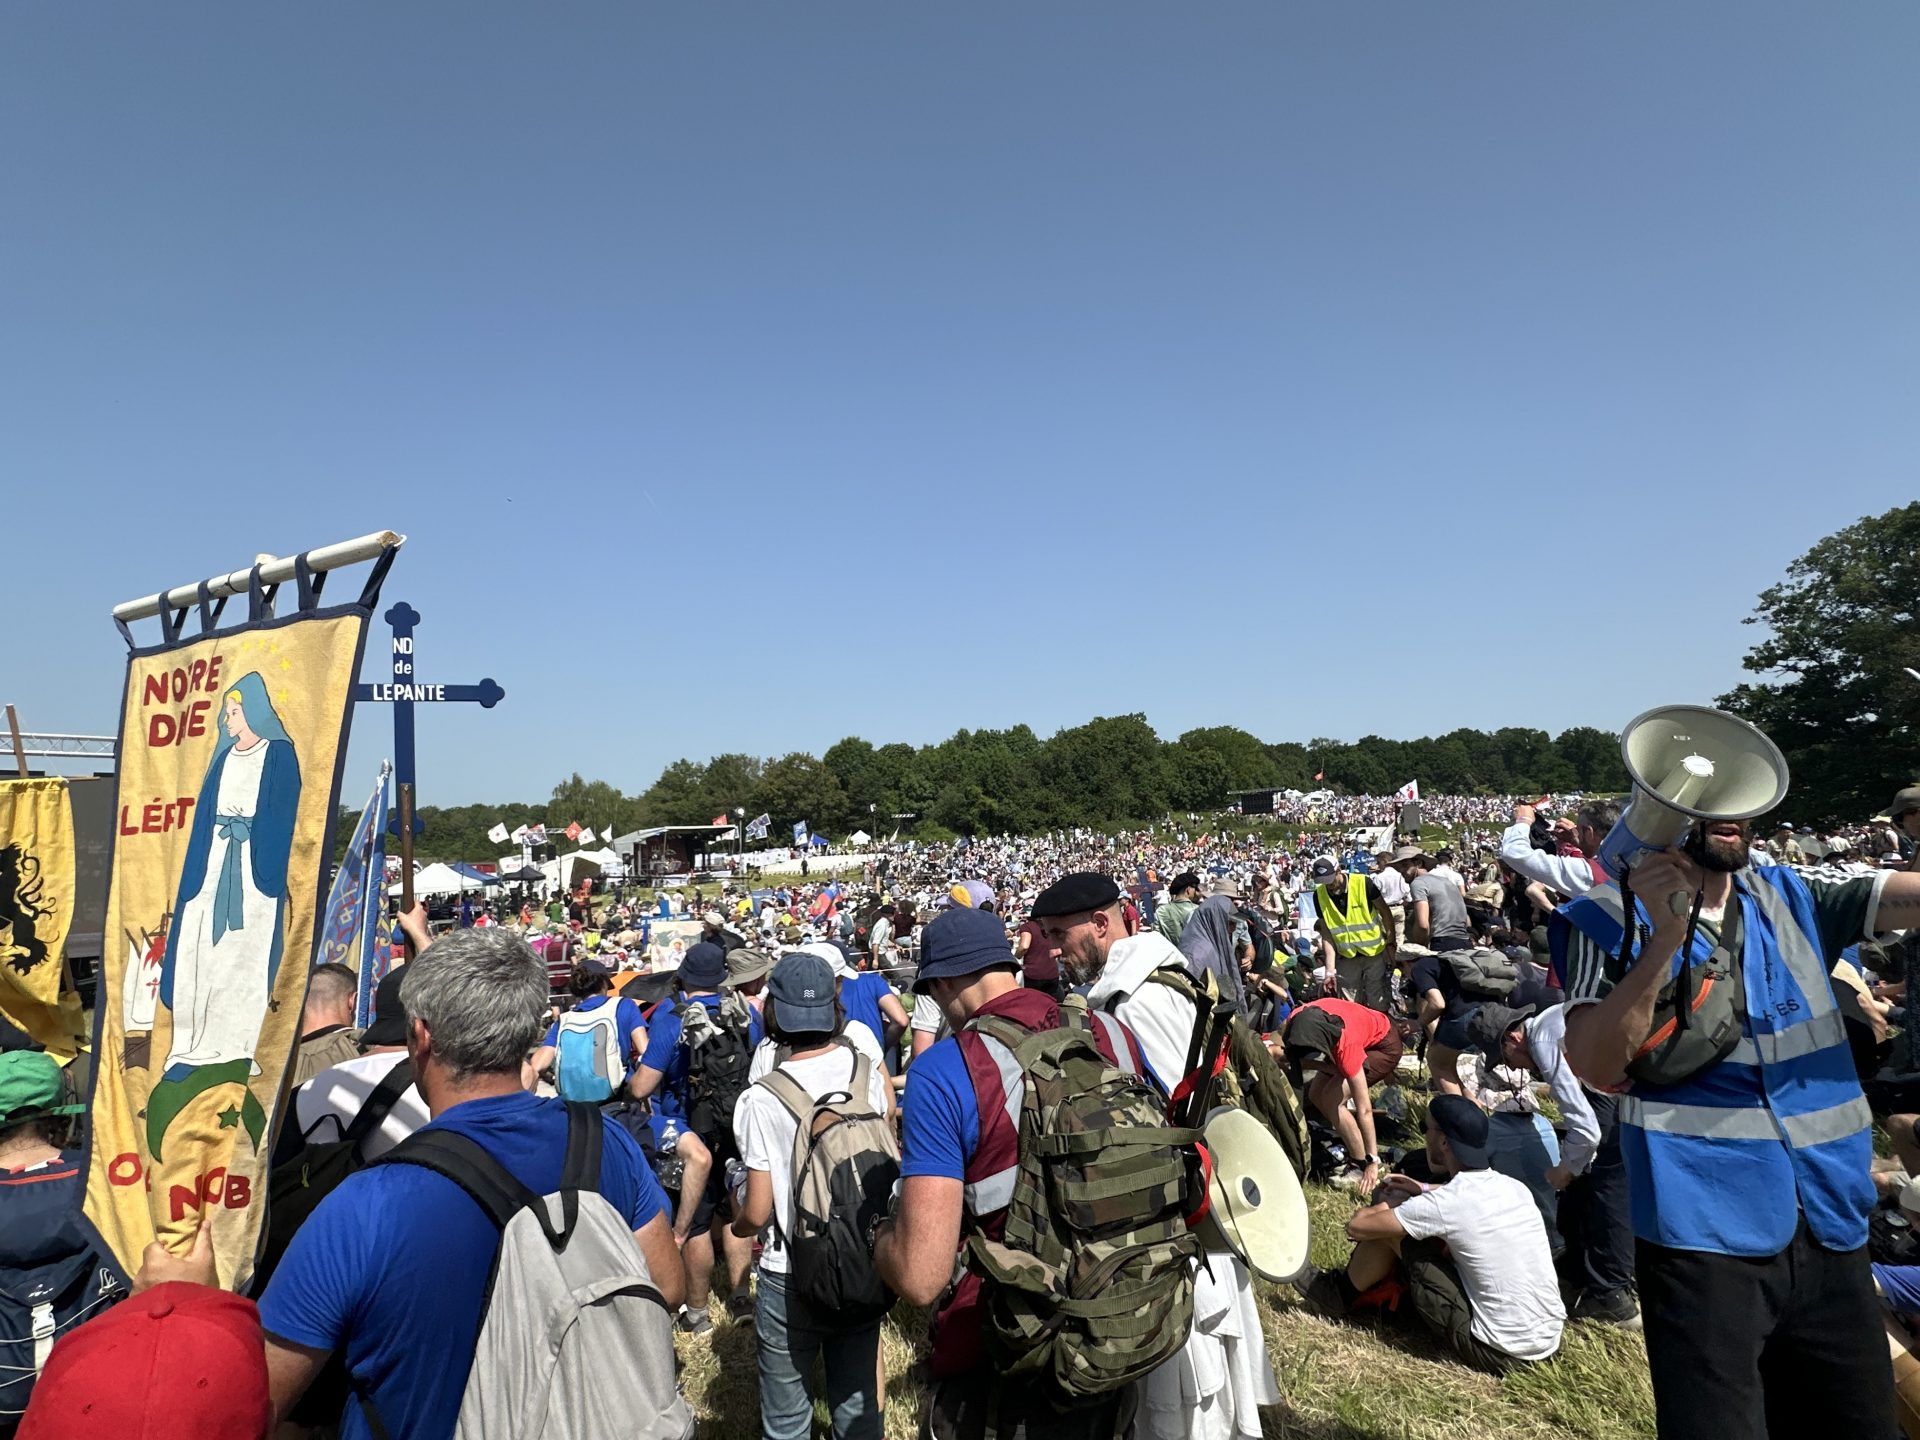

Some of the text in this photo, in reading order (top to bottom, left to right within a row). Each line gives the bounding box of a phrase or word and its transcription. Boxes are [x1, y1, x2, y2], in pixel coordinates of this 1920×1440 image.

[393, 637, 413, 654] ND
[394, 660, 412, 674] de
[143, 656, 223, 706] NORE
[373, 684, 445, 701] LEPANTE
